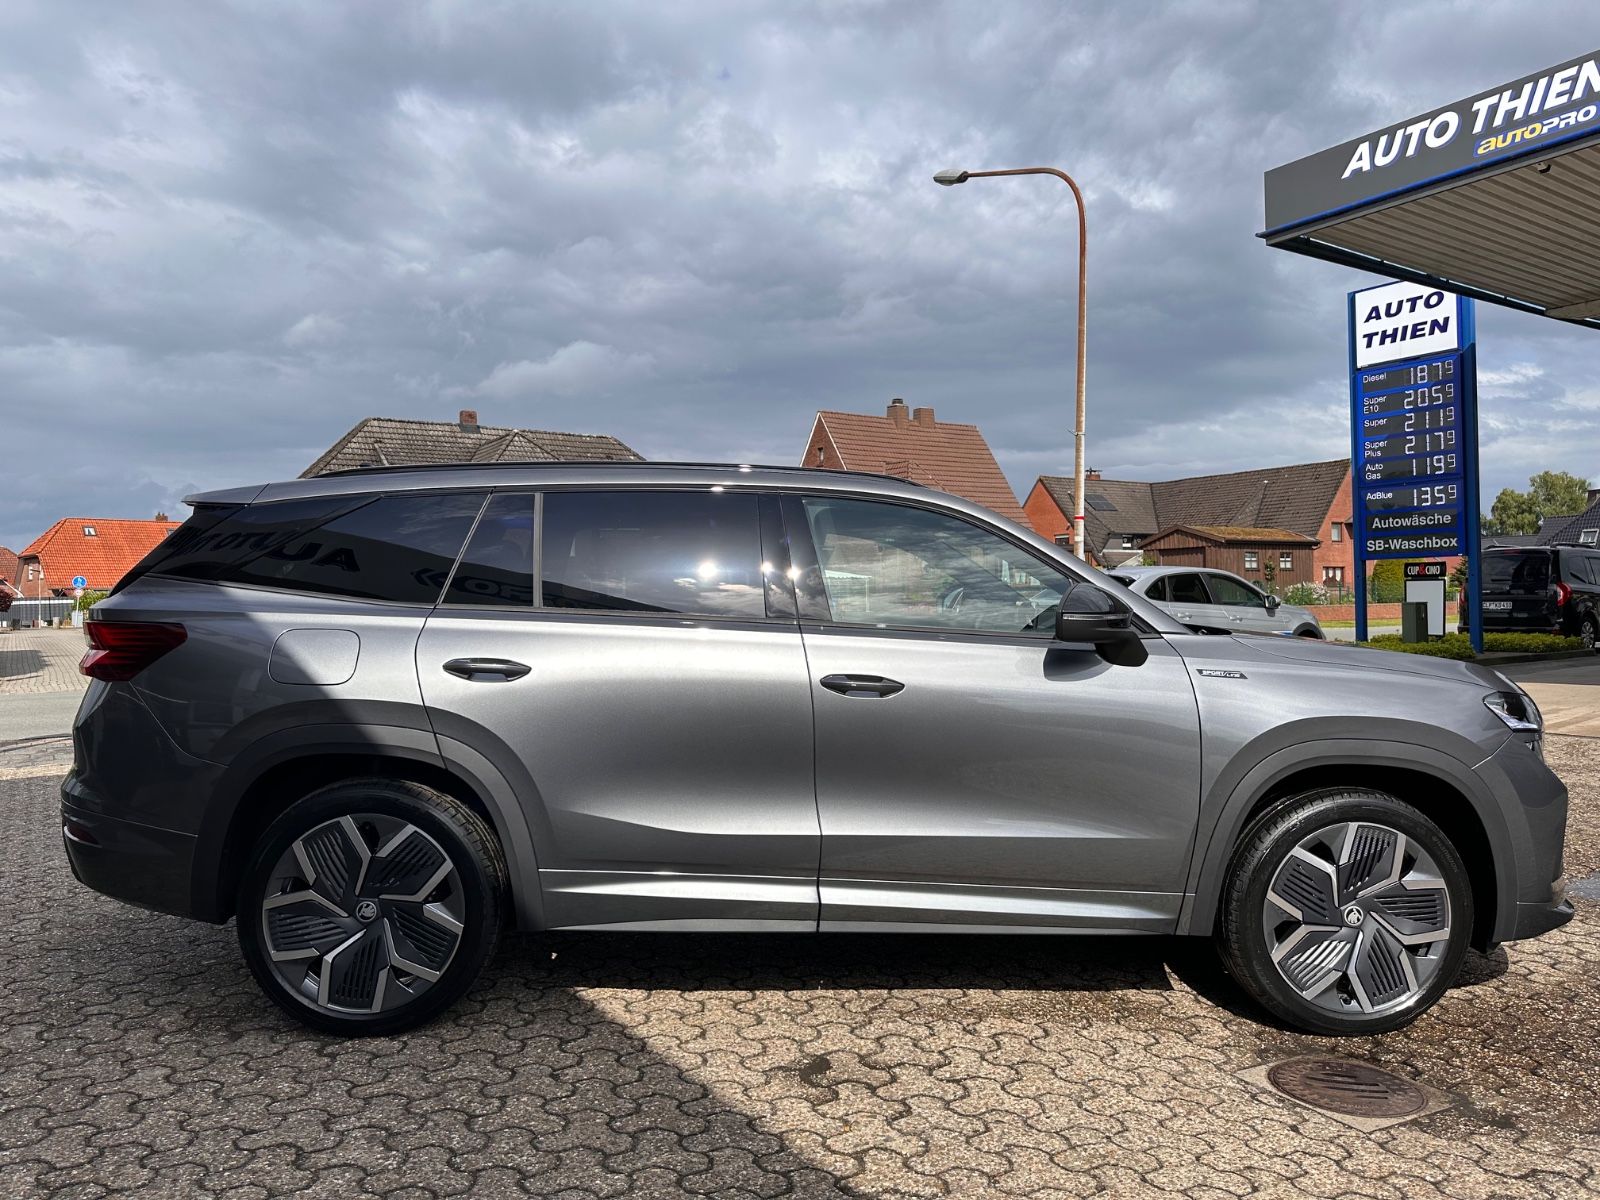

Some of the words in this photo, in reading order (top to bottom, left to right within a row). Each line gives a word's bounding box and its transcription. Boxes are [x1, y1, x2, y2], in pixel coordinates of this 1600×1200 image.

[1341, 111, 1460, 179] AUTO
[1471, 59, 1600, 135] THIEN
[1363, 290, 1445, 324] AUTO
[1362, 316, 1450, 349] THIEN
[1362, 372, 1387, 384] Diesel
[1363, 395, 1387, 406] Super
[1363, 405, 1380, 414] E10
[1363, 418, 1388, 428] Super
[1364, 440, 1388, 450] Super
[1364, 449, 1382, 459] Plus
[1365, 463, 1384, 472] Auto
[1365, 471, 1382, 480] Gas
[1366, 491, 1393, 501] AdBlue
[1372, 513, 1452, 529] Autowäsche
[1366, 536, 1458, 551] SB-Waschbox
